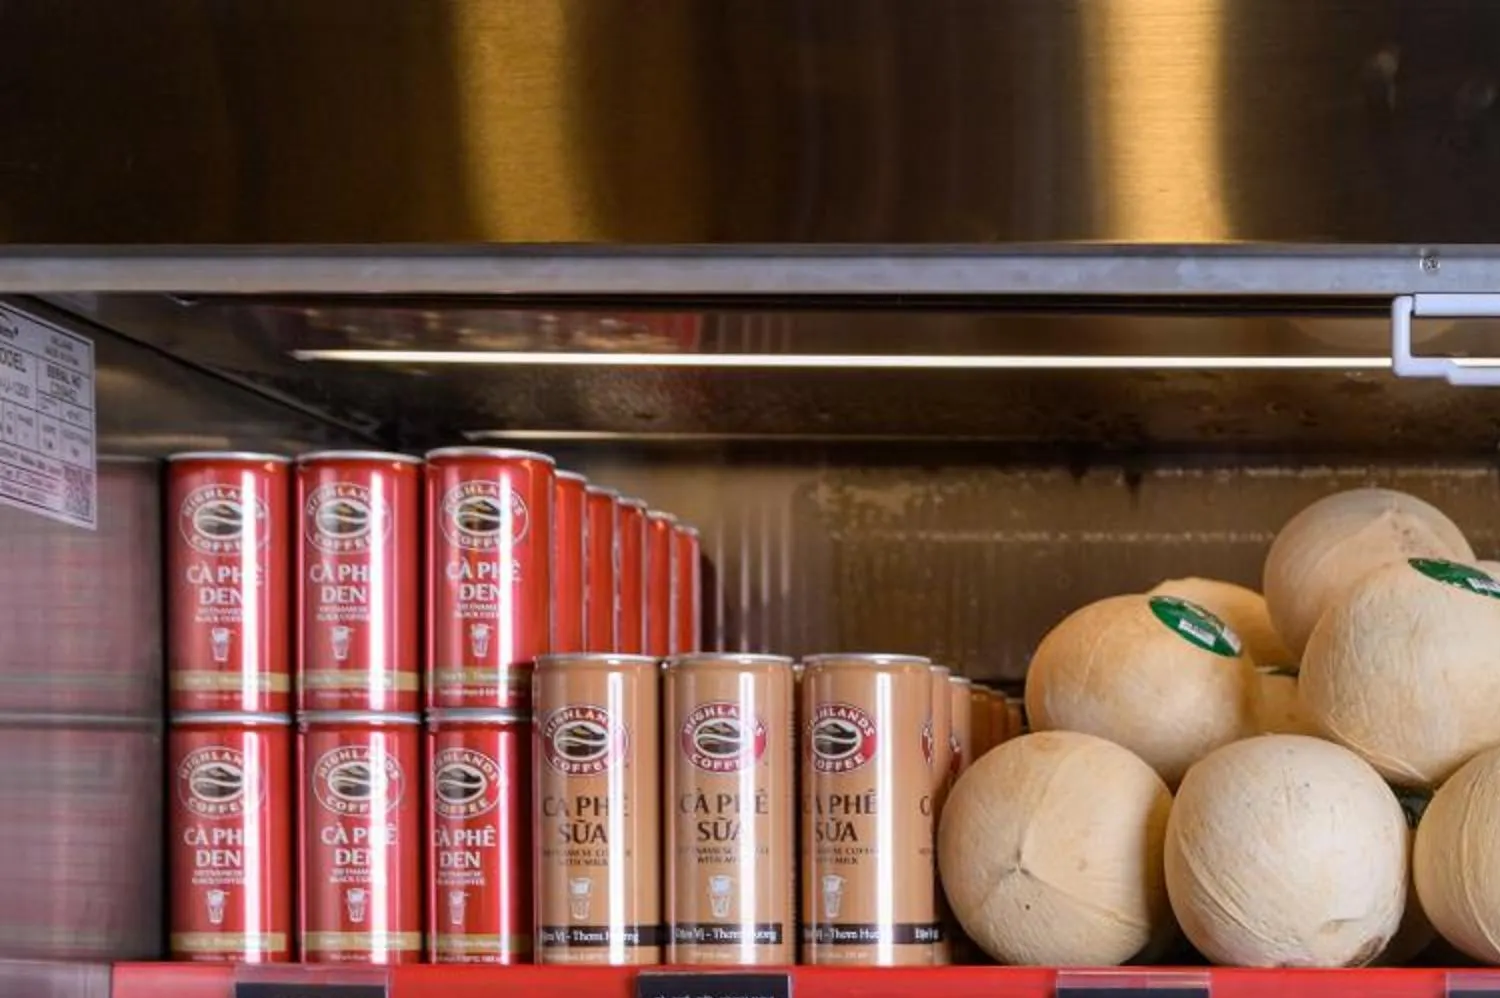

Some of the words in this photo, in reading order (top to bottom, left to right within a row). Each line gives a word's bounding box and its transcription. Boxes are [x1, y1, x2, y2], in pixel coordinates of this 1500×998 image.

[338, 563, 371, 582] PH
[545, 708, 609, 738] HIGHLAN
[212, 827, 243, 846] PH
[321, 821, 349, 845] CÀ
[453, 824, 497, 847] PHÊ
